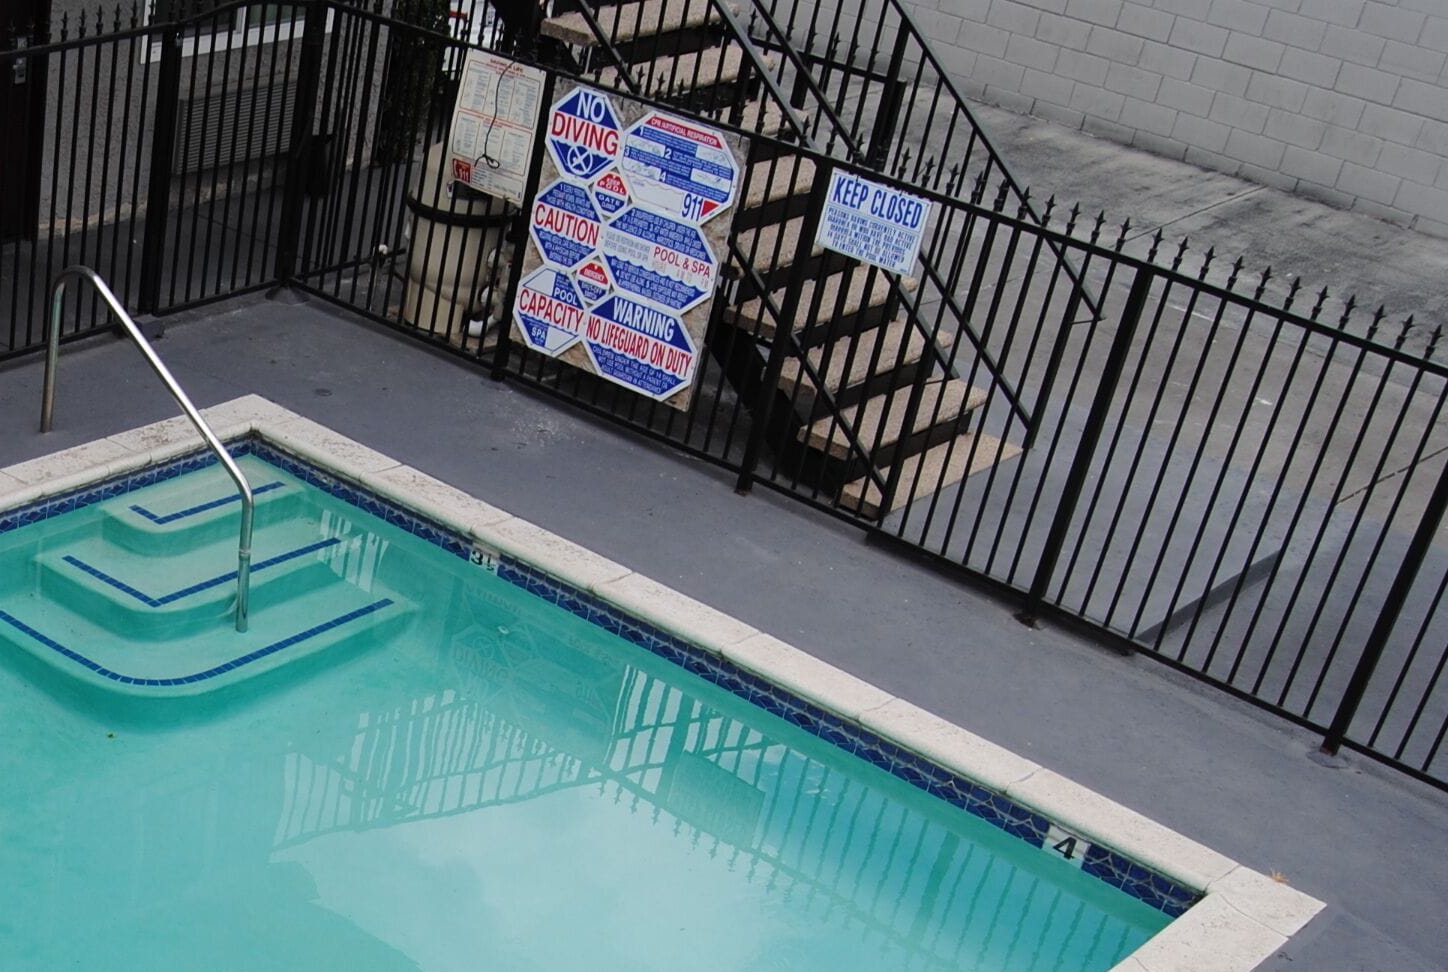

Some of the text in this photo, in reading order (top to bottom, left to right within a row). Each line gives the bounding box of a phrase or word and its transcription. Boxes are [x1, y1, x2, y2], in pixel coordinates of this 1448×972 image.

[576, 91, 607, 125] NO
[551, 112, 620, 157] DIVING
[599, 194, 620, 207] GATE
[600, 180, 625, 194] POOL
[832, 176, 923, 229] KEEP CLOSED
[681, 193, 704, 222] 911
[534, 203, 600, 247] CAUTION
[654, 246, 681, 267] POOL
[682, 257, 690, 270] &
[691, 260, 711, 278] SPA
[519, 288, 584, 333] CAPACITY
[554, 287, 579, 306] POOL
[532, 327, 546, 340] SPA
[612, 296, 676, 342] WARNING
[586, 316, 692, 378] NO LIFEGUARD ON DUTY
[1053, 837, 1077, 860] 4
